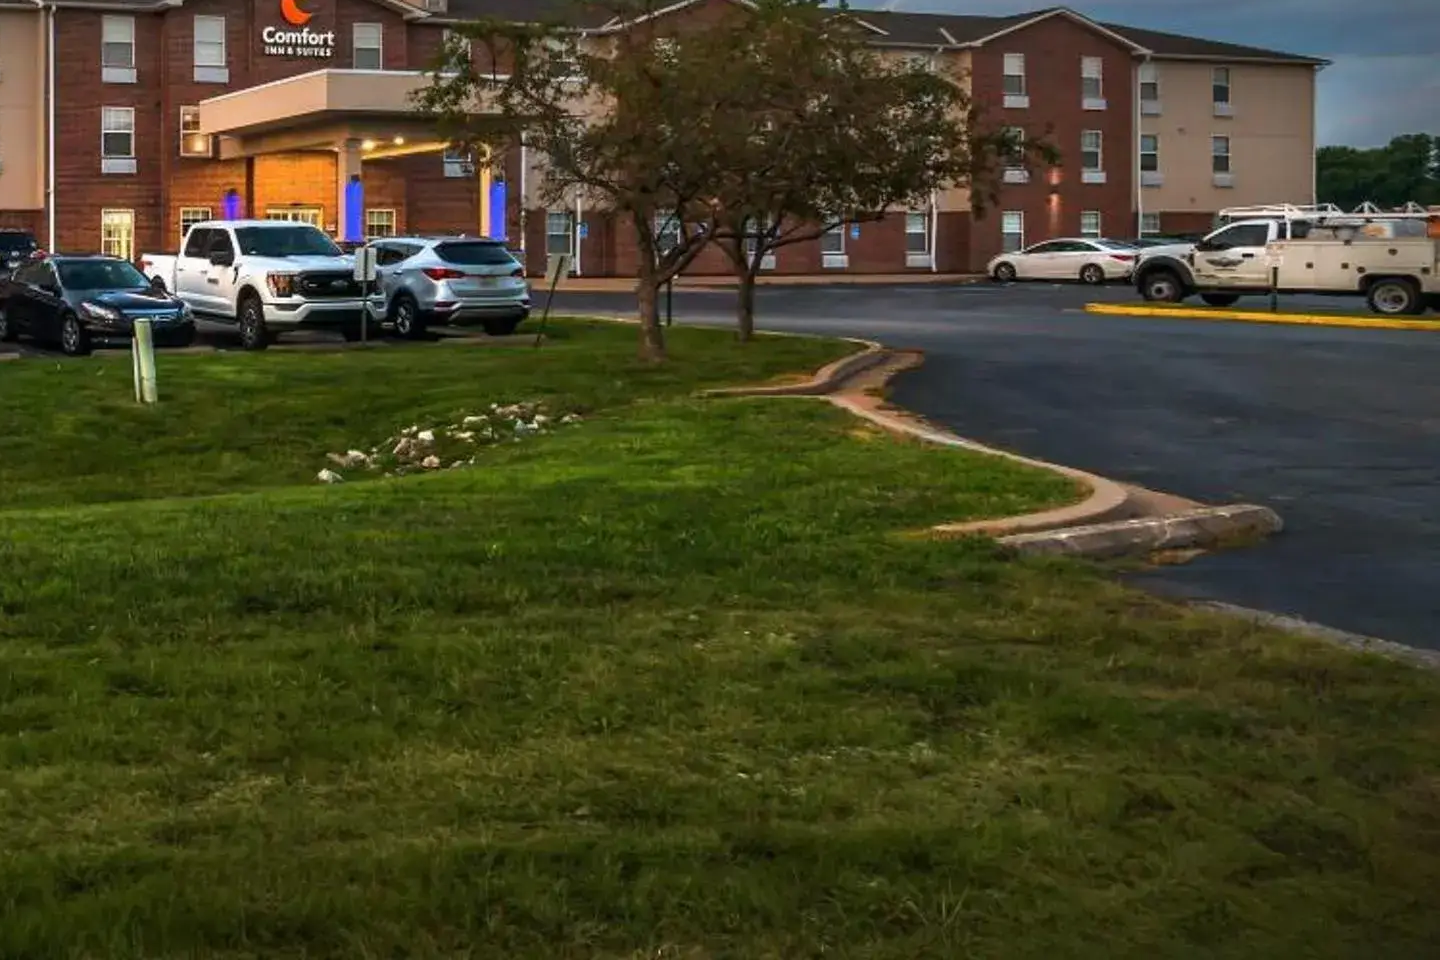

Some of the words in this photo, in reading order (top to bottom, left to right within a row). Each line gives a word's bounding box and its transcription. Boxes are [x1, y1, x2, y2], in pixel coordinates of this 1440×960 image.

[262, 26, 335, 46] Comfort
[264, 45, 285, 55] INN
[286, 45, 294, 55] &
[296, 46, 332, 57] SUITES
